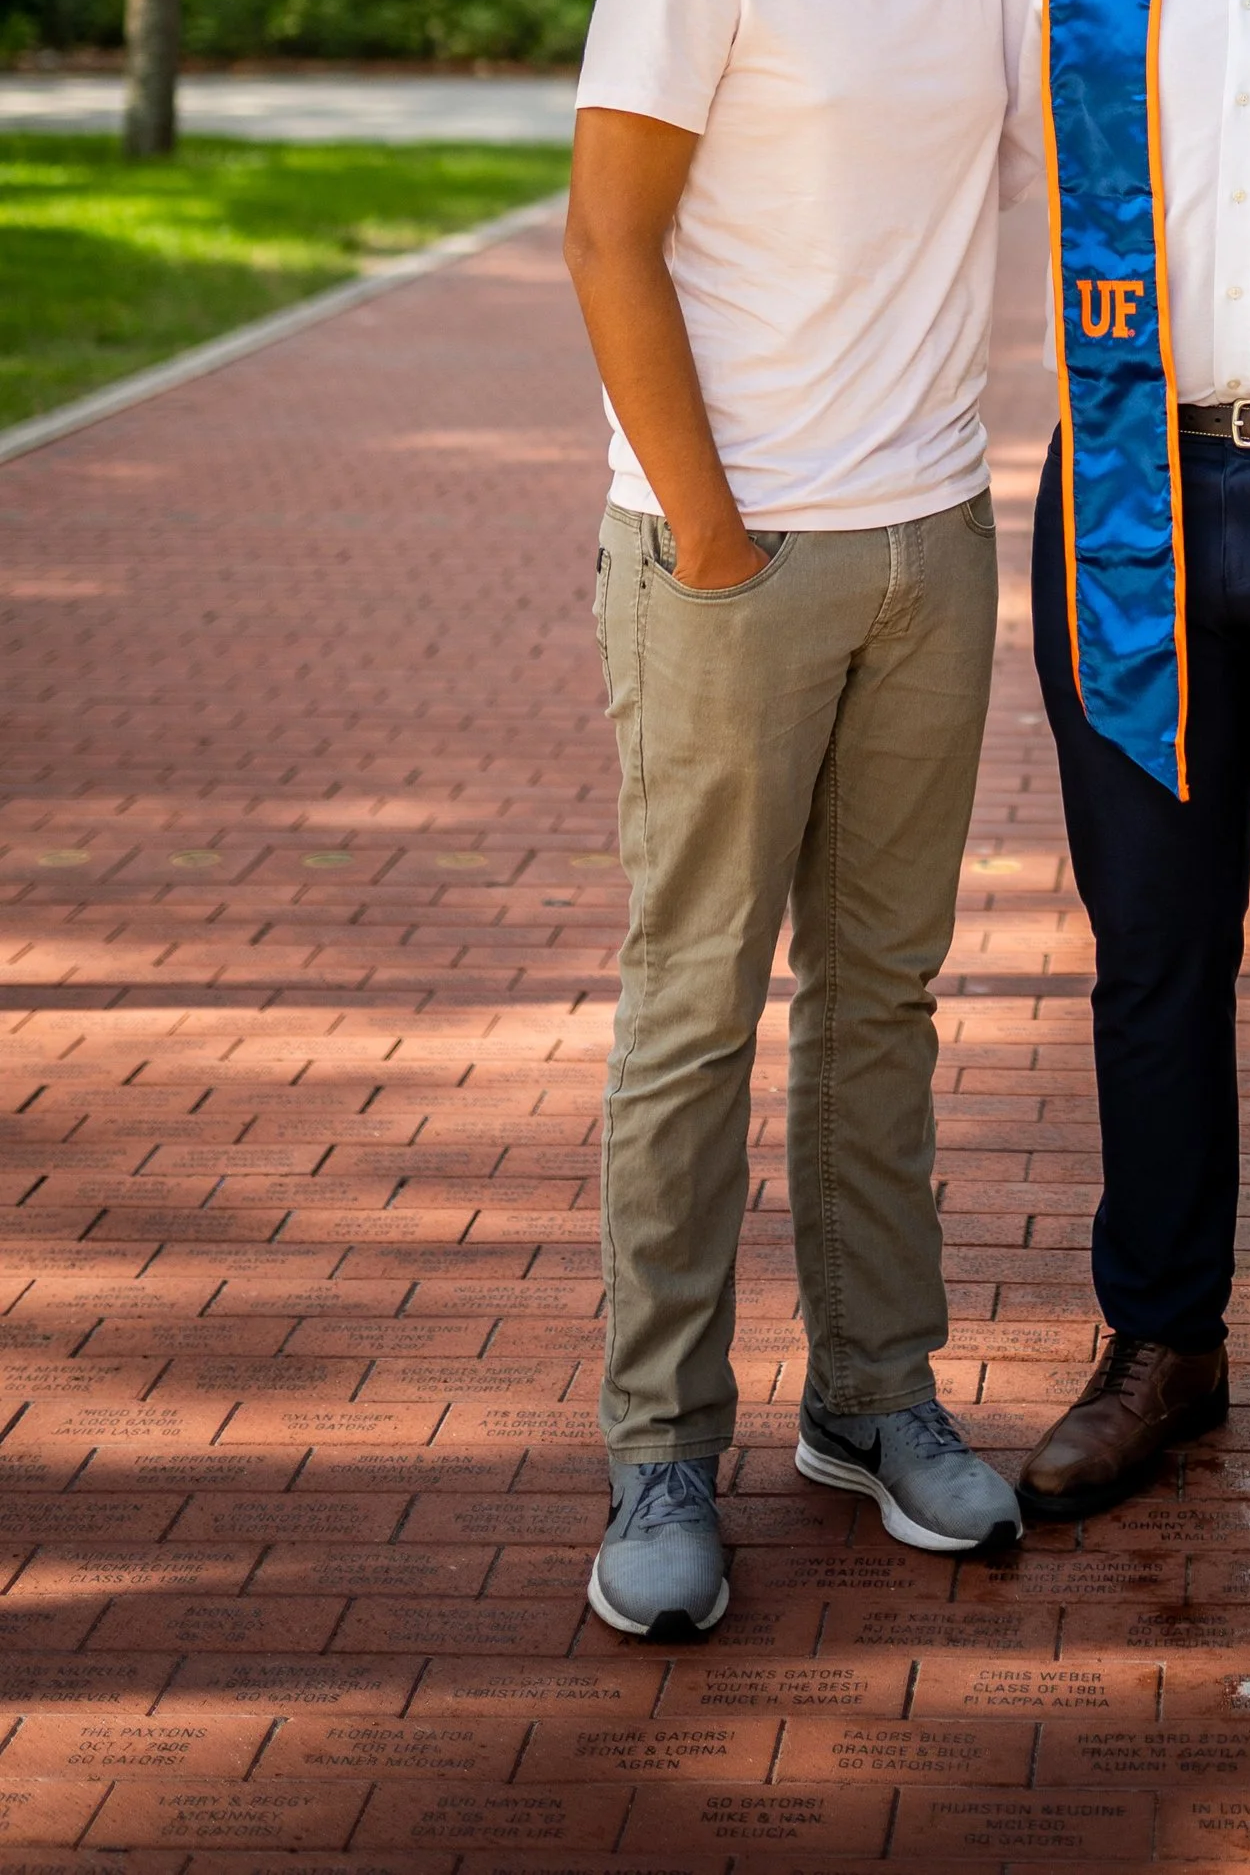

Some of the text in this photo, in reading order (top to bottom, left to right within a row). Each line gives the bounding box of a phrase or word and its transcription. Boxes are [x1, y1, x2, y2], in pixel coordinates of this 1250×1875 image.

[1076, 279, 1144, 338] UF
[704, 1669, 855, 1679] THANKS GATORS
[979, 1670, 1102, 1682] CHRIS WEBER
[776, 1682, 869, 1692] THE BEST!
[973, 1683, 1106, 1694] CLASS OF 1981
[453, 1689, 551, 1699] CHRISTINE
[700, 1694, 864, 1705] BRUCE SAVAGE
[987, 1696, 1110, 1708] KAPPA ALPHA
[81, 1728, 208, 1738] THE PAXTONS
[577, 1731, 734, 1742] FUTURE GATORS!
[919, 1731, 975, 1743] BLEED
[1077, 1734, 1136, 1744] HAPPY
[148, 1742, 190, 1752] 2006
[574, 1745, 727, 1756] STONE & LORNA
[831, 1744, 929, 1756] ORANGE &
[67, 1755, 186, 1764] GO GATORS!
[614, 1759, 680, 1769] AGREN
[838, 1759, 863, 1769] GO
[706, 1797, 825, 1808] GO GATORS!
[1192, 1803, 1212, 1813] IN
[930, 1802, 1034, 1815] THURSTON
[175, 1810, 282, 1821] MCKINNEY
[701, 1812, 769, 1823] MIKE &
[196, 1825, 283, 1837] GATORS!
[716, 1827, 797, 1838] DELUCIA
[964, 1834, 1084, 1845] GO GATORS!
